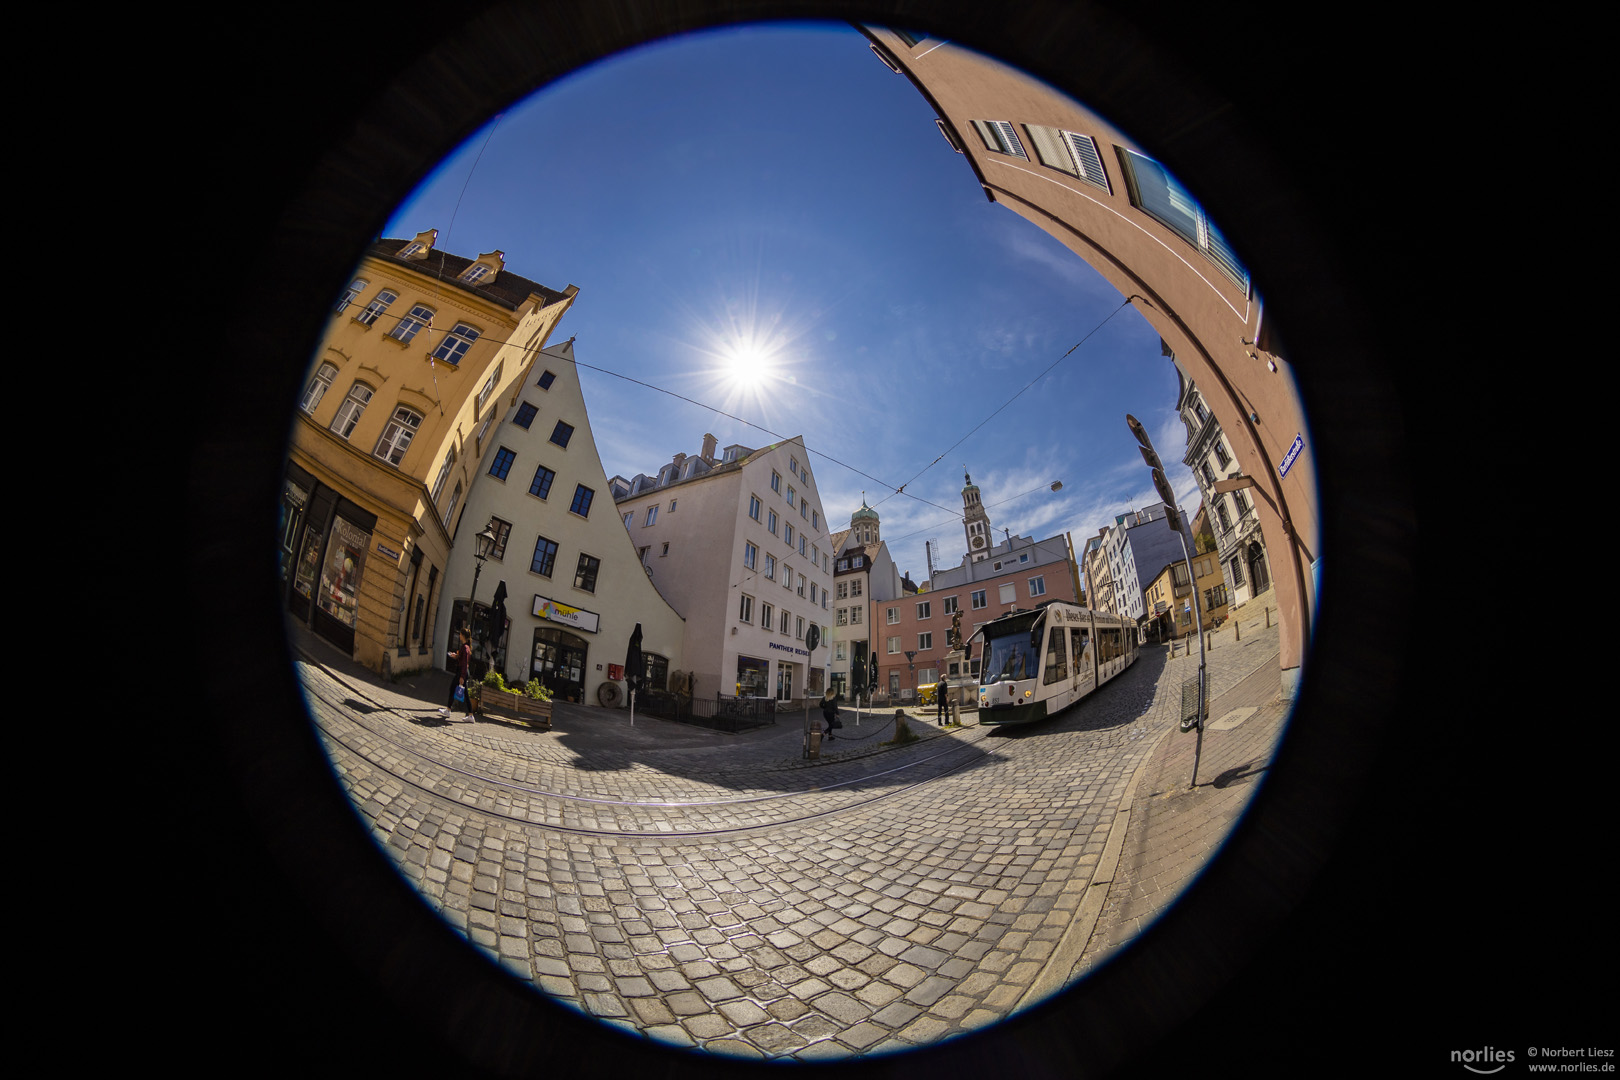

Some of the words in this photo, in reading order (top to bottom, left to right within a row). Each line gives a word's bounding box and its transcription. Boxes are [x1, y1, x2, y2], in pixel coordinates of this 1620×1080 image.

[337, 521, 366, 548] Kolonial
[554, 608, 578, 620] mühle
[769, 642, 794, 653] PANTHER
